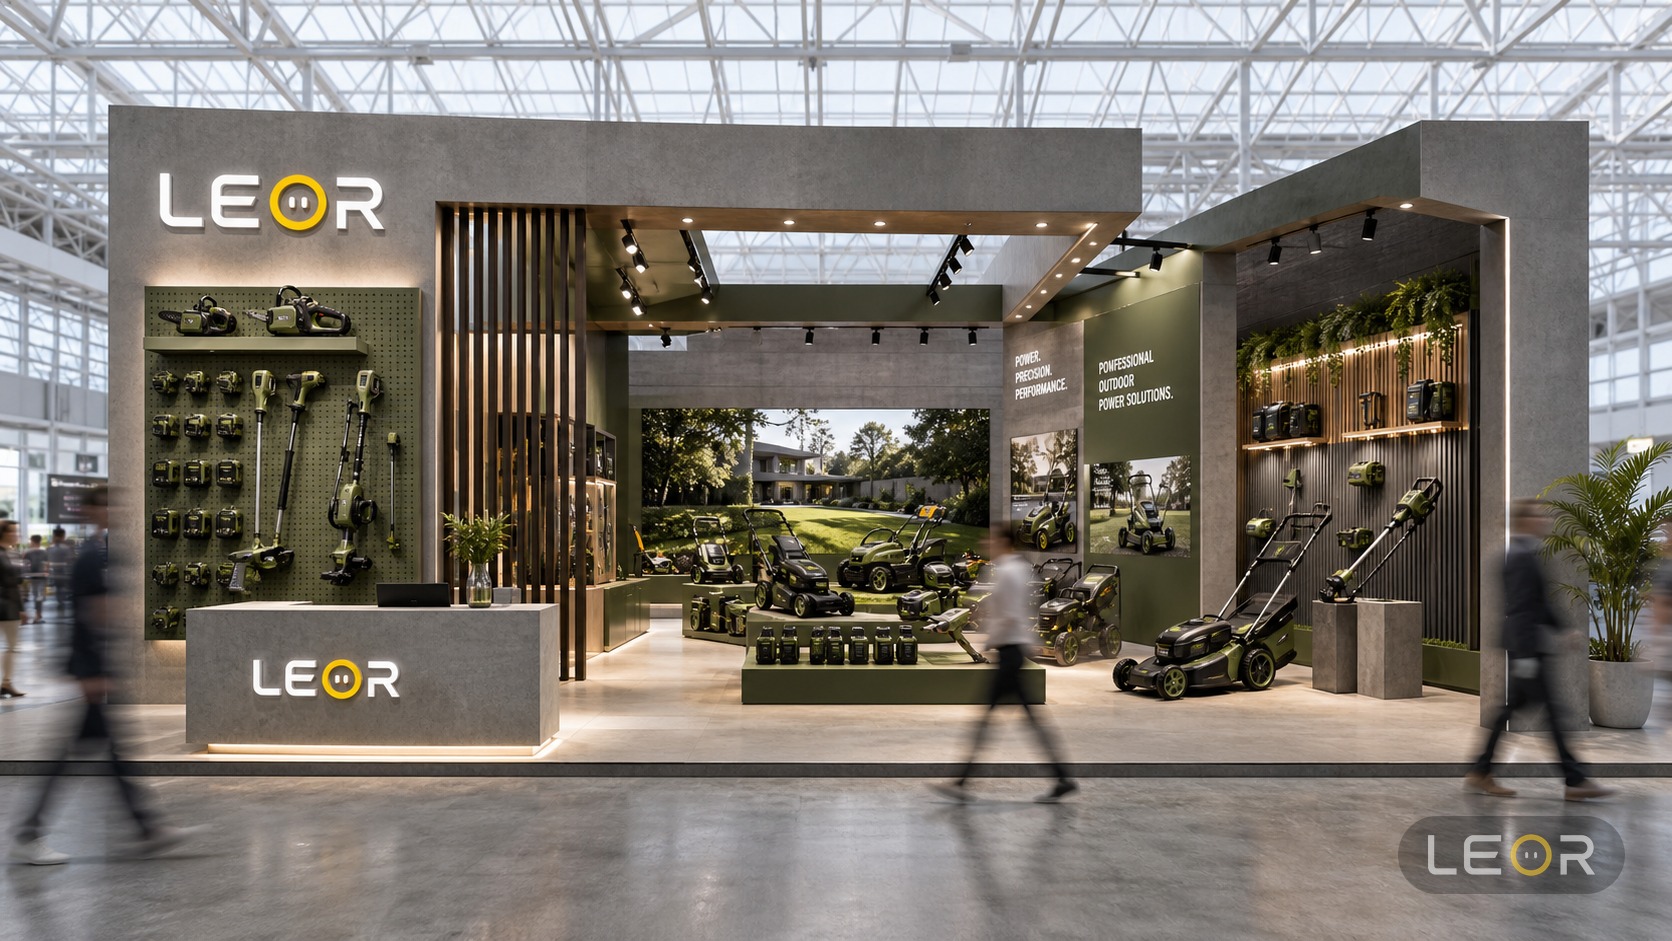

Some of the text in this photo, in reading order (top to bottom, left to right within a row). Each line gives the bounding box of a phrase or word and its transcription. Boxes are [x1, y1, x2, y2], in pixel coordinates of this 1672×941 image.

[159, 173, 385, 231] LEOR
[1015, 350, 1041, 368] POWER.
[1015, 377, 1068, 400] PERFORMANCE.
[1098, 373, 1135, 393] OUTDOOR
[1098, 385, 1174, 412] POWER SOLUTIONS.
[252, 659, 400, 700] LEOR
